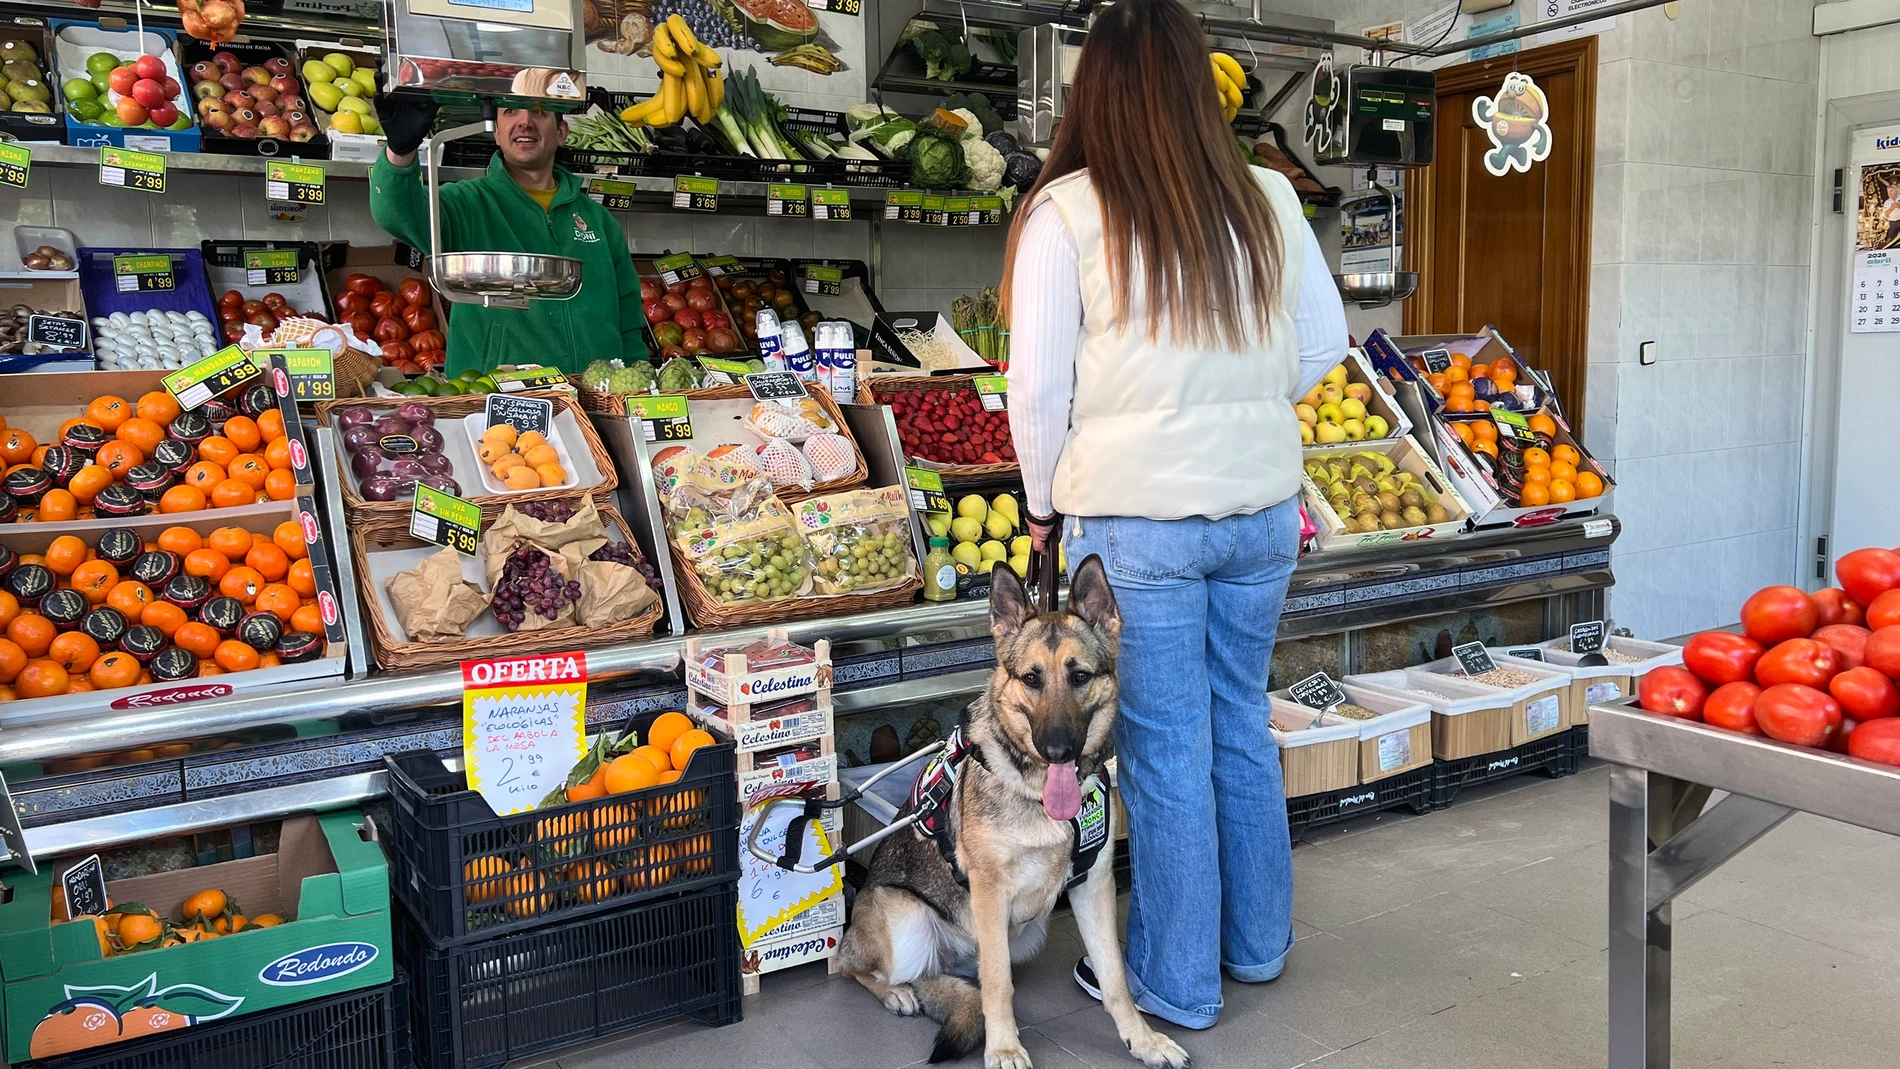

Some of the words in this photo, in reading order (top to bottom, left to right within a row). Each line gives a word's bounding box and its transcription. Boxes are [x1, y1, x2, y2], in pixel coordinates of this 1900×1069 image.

[1876, 136, 1900, 149] kid
[135, 175, 163, 189] 2'99
[297, 188, 323, 201] 3'99
[609, 198, 630, 208] 9'99
[696, 197, 716, 208] 3'69
[788, 204, 805, 214] 2'99
[833, 208, 850, 218] 1'99
[904, 209, 920, 219] 3'99
[926, 213, 942, 223] 1'99
[985, 214, 1000, 223] 3'50
[952, 215, 968, 225] 2'50
[147, 277, 172, 289] 4'99
[274, 271, 298, 282] 3'99
[1860, 293, 1867, 301] 13
[193, 350, 241, 377] MANDARINAS
[288, 357, 321, 367] PAPAYON
[220, 364, 256, 387] 4'99
[297, 381, 332, 396] 4'99
[656, 402, 679, 412] MANGO
[664, 423, 691, 439] 5'99
[452, 501, 466, 513] UVA
[439, 507, 450, 518] SIN
[451, 512, 476, 527] PEPITAS
[447, 528, 476, 551] 5'99
[471, 655, 580, 685] OFERTA
[751, 676, 813, 695] Celestino
[128, 685, 227, 709] Redondo
[488, 702, 559, 719] NARANJAS
[487, 734, 510, 744] DEL
[549, 729, 558, 738] A
[741, 729, 791, 746] Celestino
[485, 743, 500, 753] LA
[505, 740, 536, 750] MESA
[763, 938, 826, 960] Celestino
[276, 945, 368, 981] Redondo
